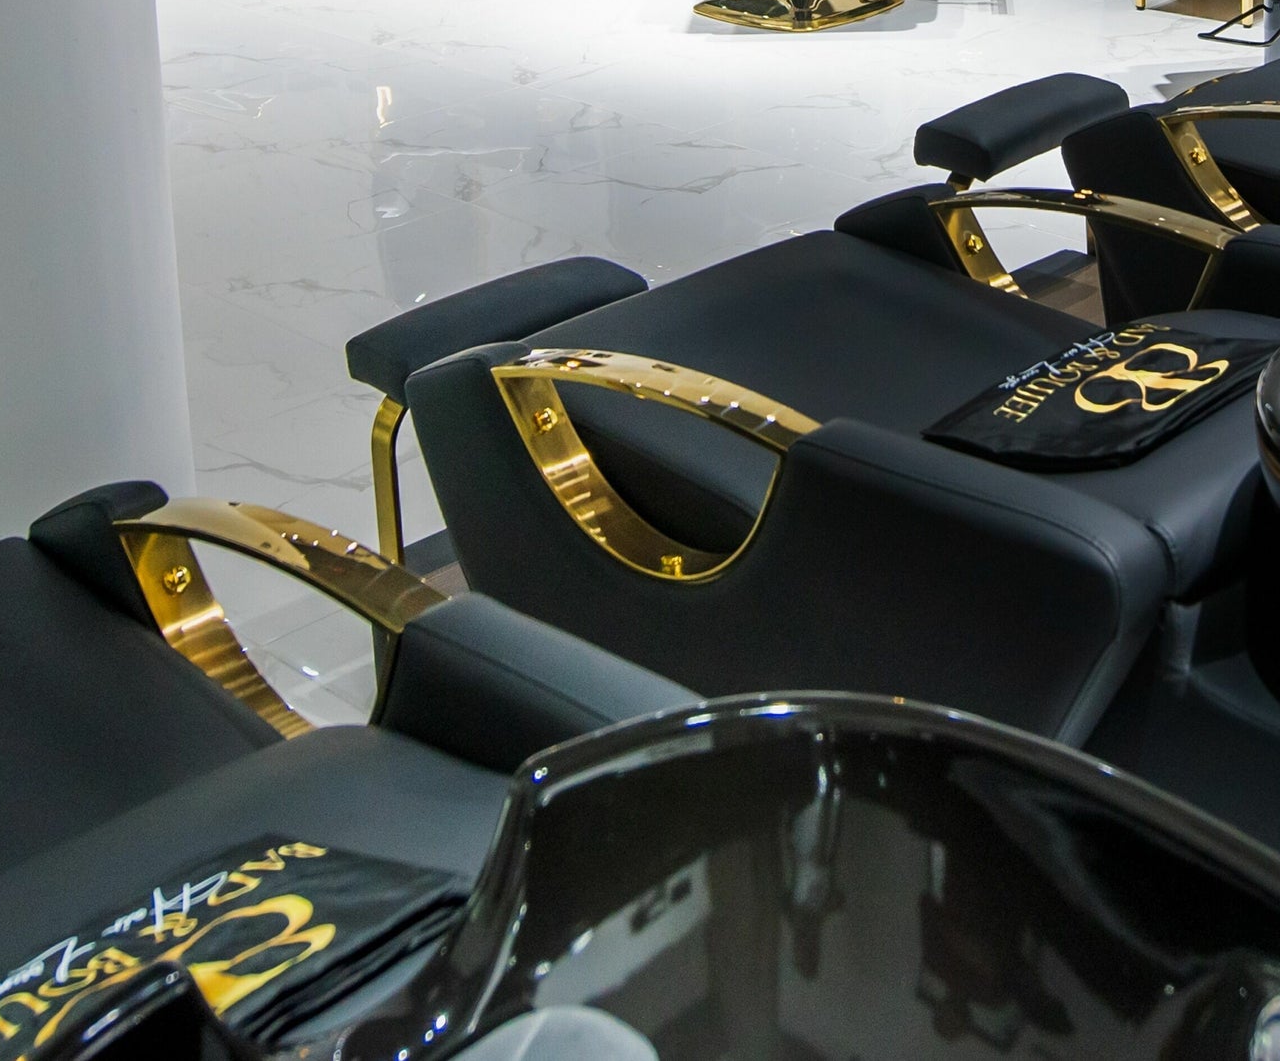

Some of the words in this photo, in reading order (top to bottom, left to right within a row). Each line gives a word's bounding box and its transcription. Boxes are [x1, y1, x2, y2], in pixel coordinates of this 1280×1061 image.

[102, 870, 230, 942] Hair
[208, 841, 329, 906] BAD
[137, 911, 199, 944] &
